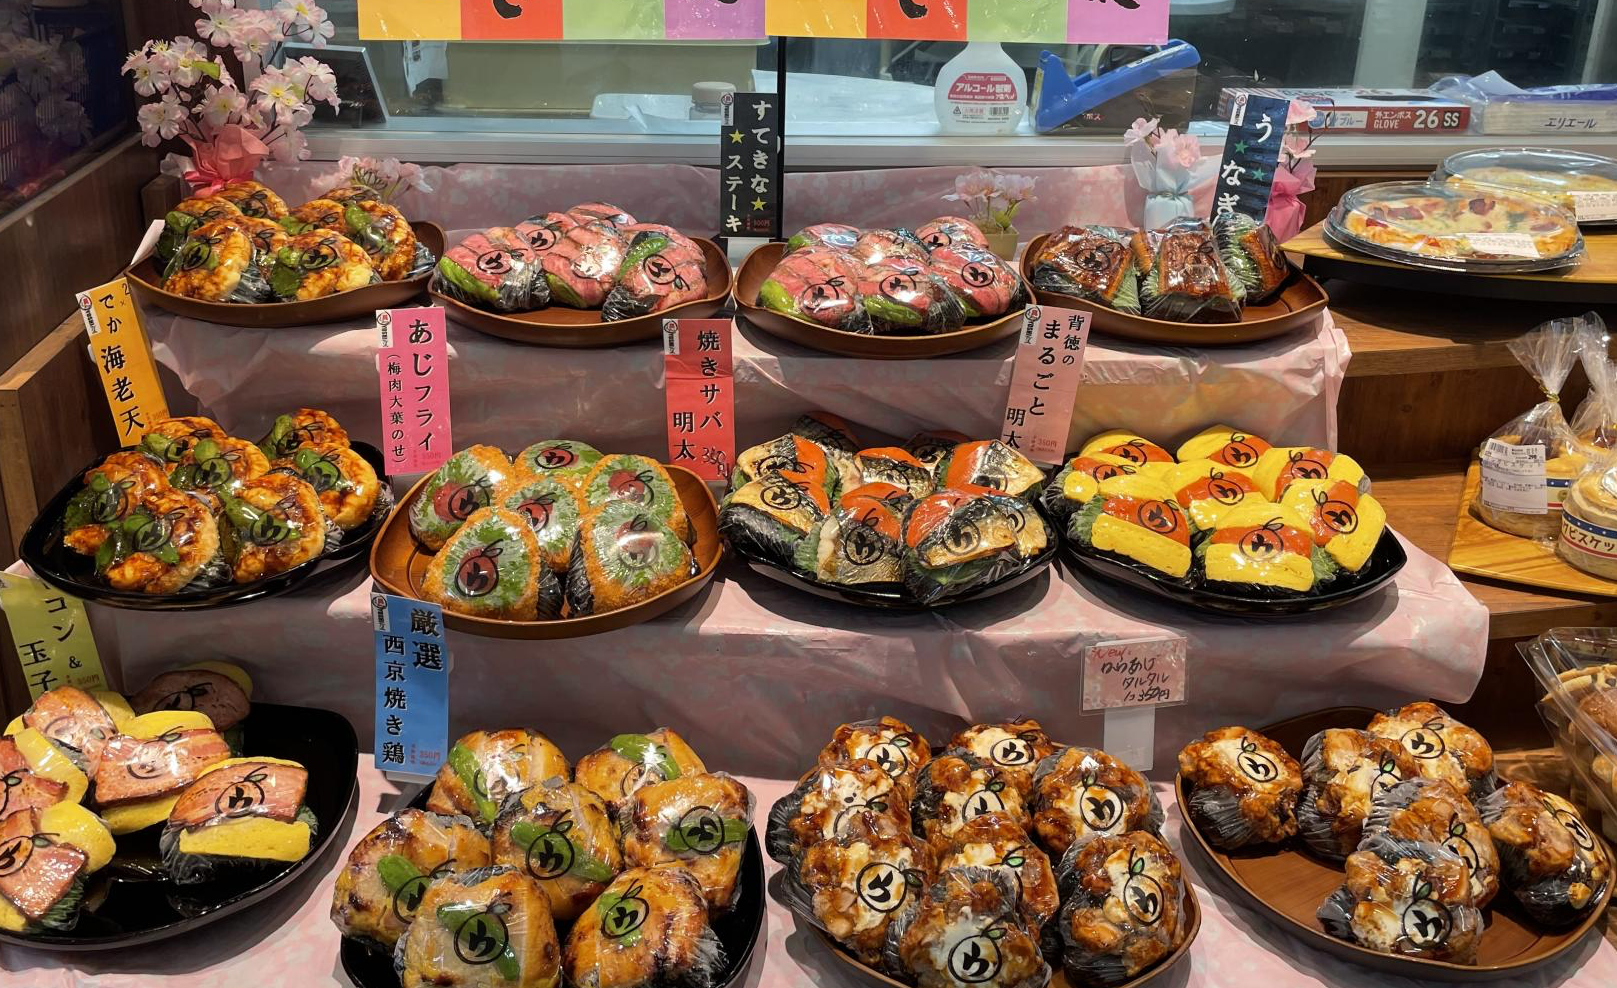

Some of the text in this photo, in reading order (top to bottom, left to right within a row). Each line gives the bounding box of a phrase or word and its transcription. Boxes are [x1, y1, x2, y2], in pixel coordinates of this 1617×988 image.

[751, 100, 772, 193] すてきな
[1374, 109, 1459, 129] GLOVE 26 SS
[1375, 111, 1412, 119] 外エンボス
[1545, 117, 1598, 130] エリエール
[725, 154, 743, 232] ステーキ
[1216, 114, 1273, 214] うなぎ
[1029, 319, 1061, 416] まるごと
[1062, 314, 1085, 366] 背徳の
[409, 319, 435, 451] あじフライ
[697, 330, 723, 430] 焼きサバ
[673, 411, 697, 461] 明太
[1003, 407, 1026, 450] 明太
[19, 641, 57, 691] 玉子
[411, 608, 443, 671] 厳選
[382, 634, 407, 764] 西京焼き鶏
